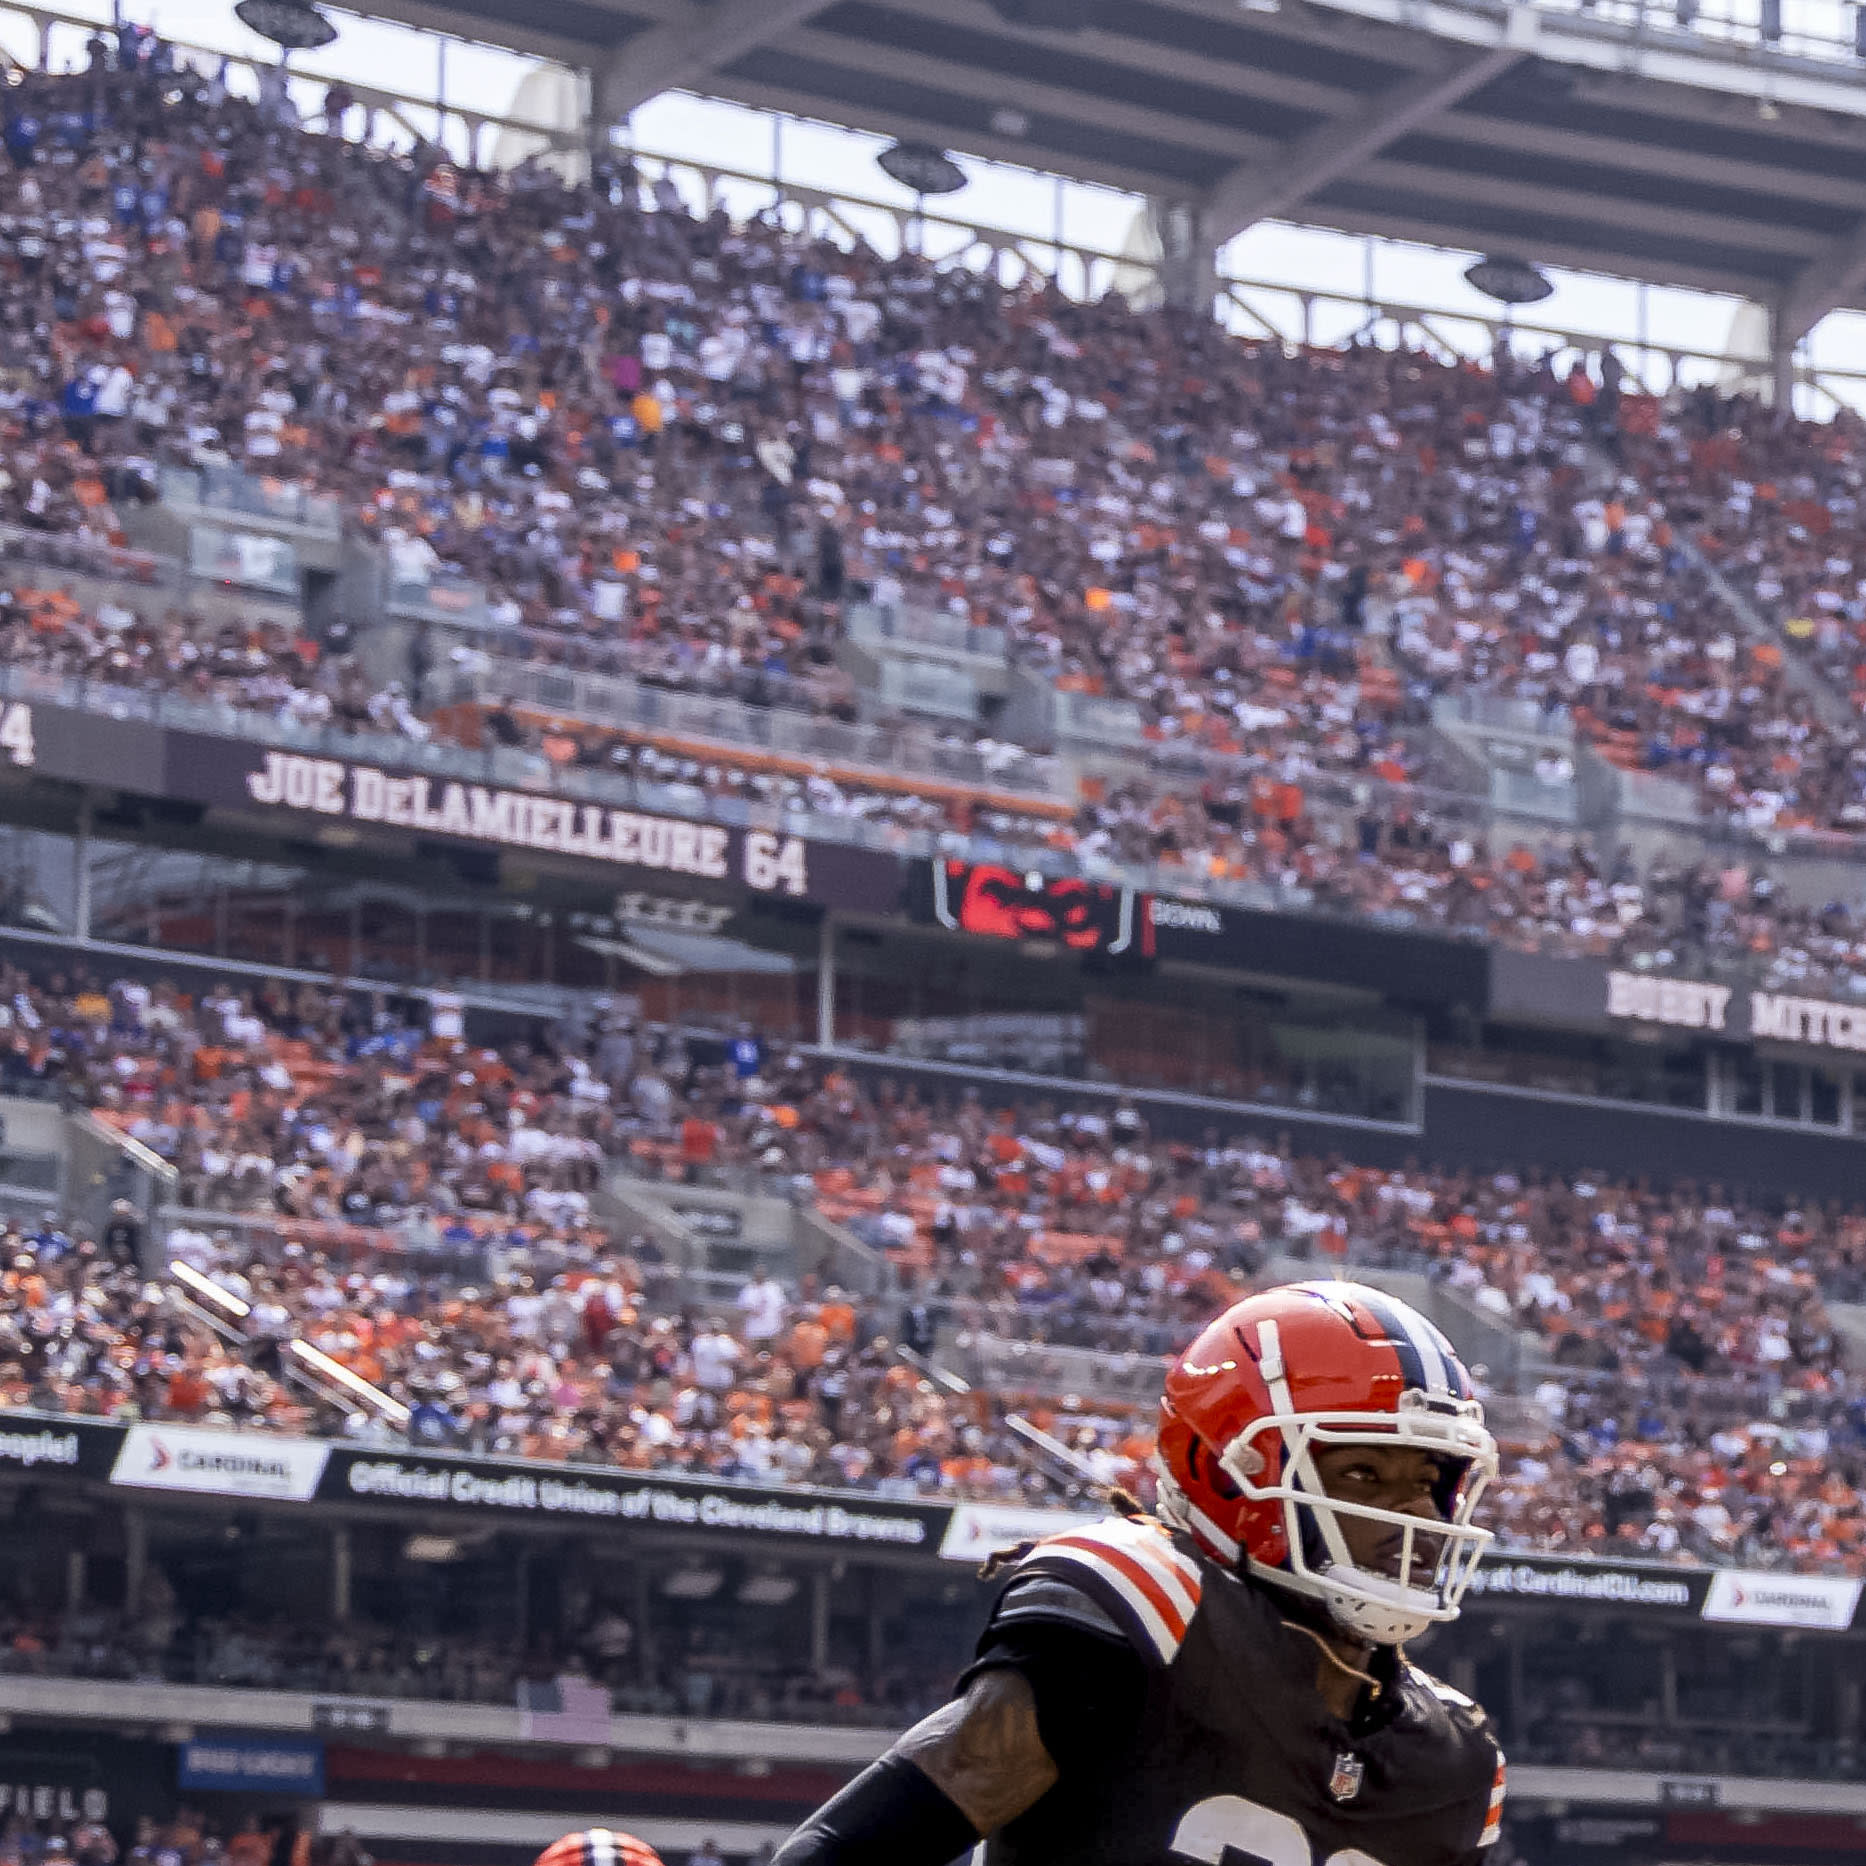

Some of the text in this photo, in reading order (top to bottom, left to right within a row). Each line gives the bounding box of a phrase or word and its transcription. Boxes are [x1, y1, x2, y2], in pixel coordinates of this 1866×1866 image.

[246, 750, 346, 813] JOE
[744, 831, 807, 895] 64
[349, 1461, 925, 1543] Official Credit Union of the Cleveland Browns
